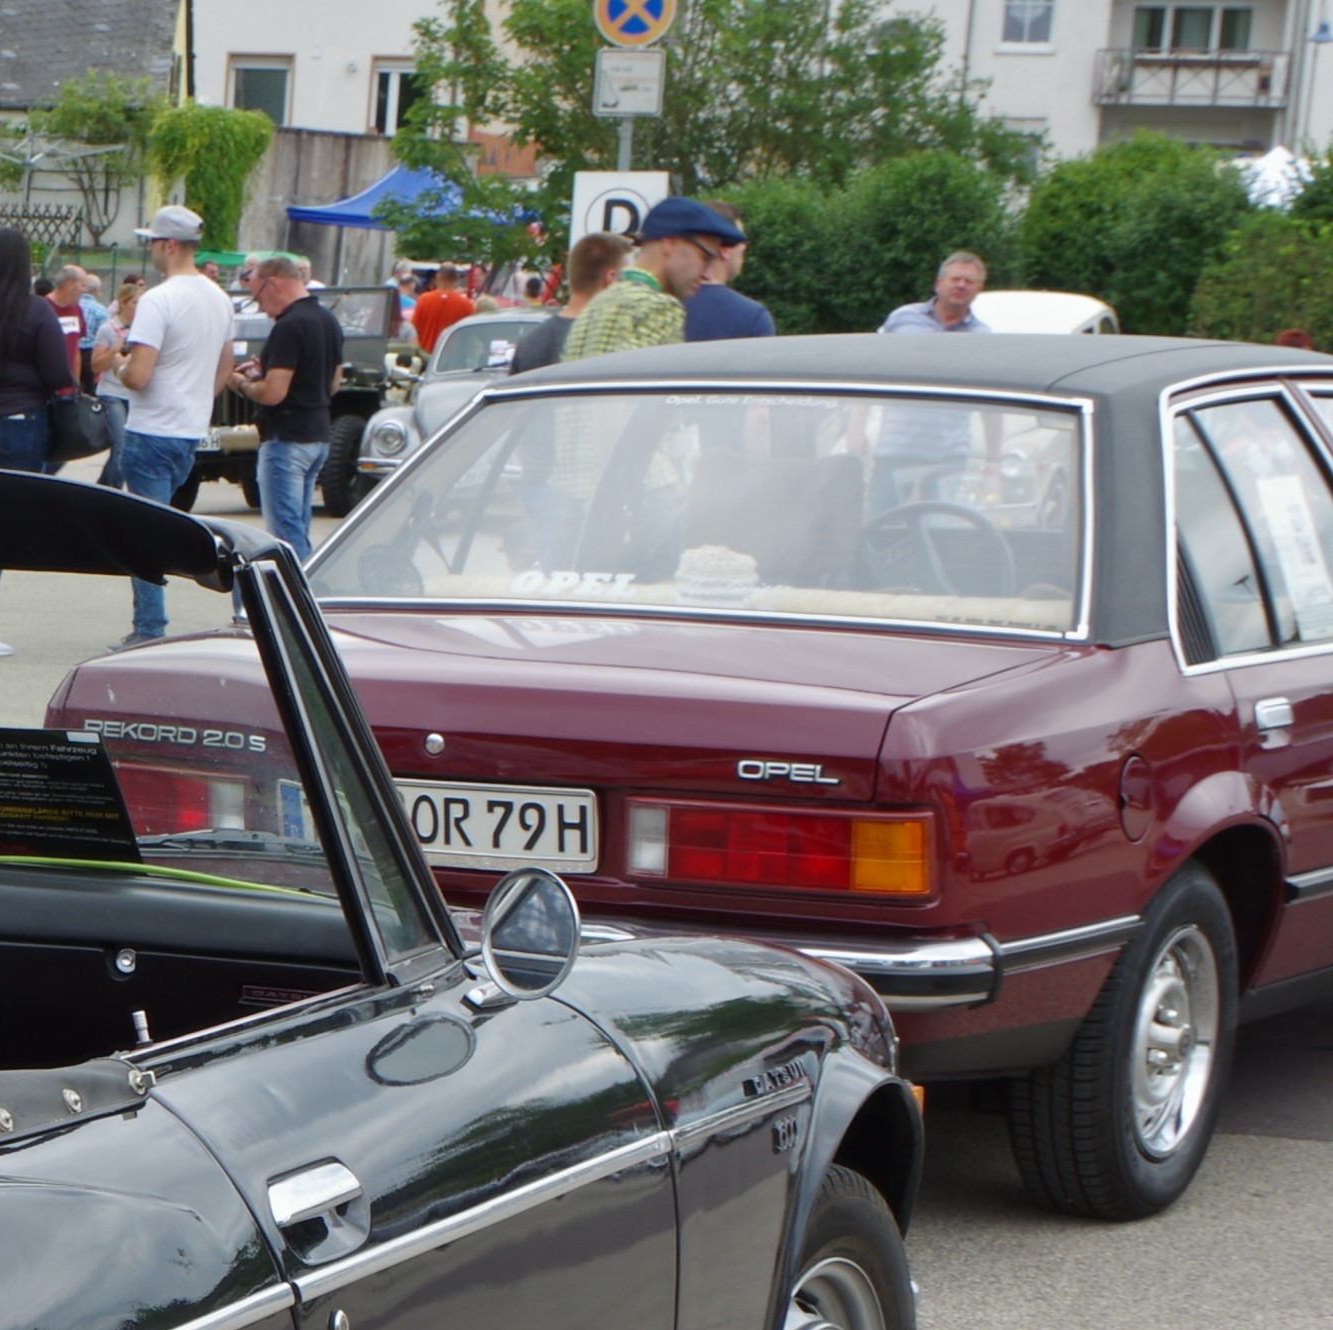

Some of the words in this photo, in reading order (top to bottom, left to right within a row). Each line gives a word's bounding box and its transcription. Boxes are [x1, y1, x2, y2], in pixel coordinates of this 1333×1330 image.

[706, 396, 739, 405] Gute
[742, 396, 838, 409] Entscheidung
[510, 570, 636, 594] OPEL
[50, 744, 98, 755] Fahrzeug
[248, 735, 266, 752] S
[738, 760, 839, 784] OPEL
